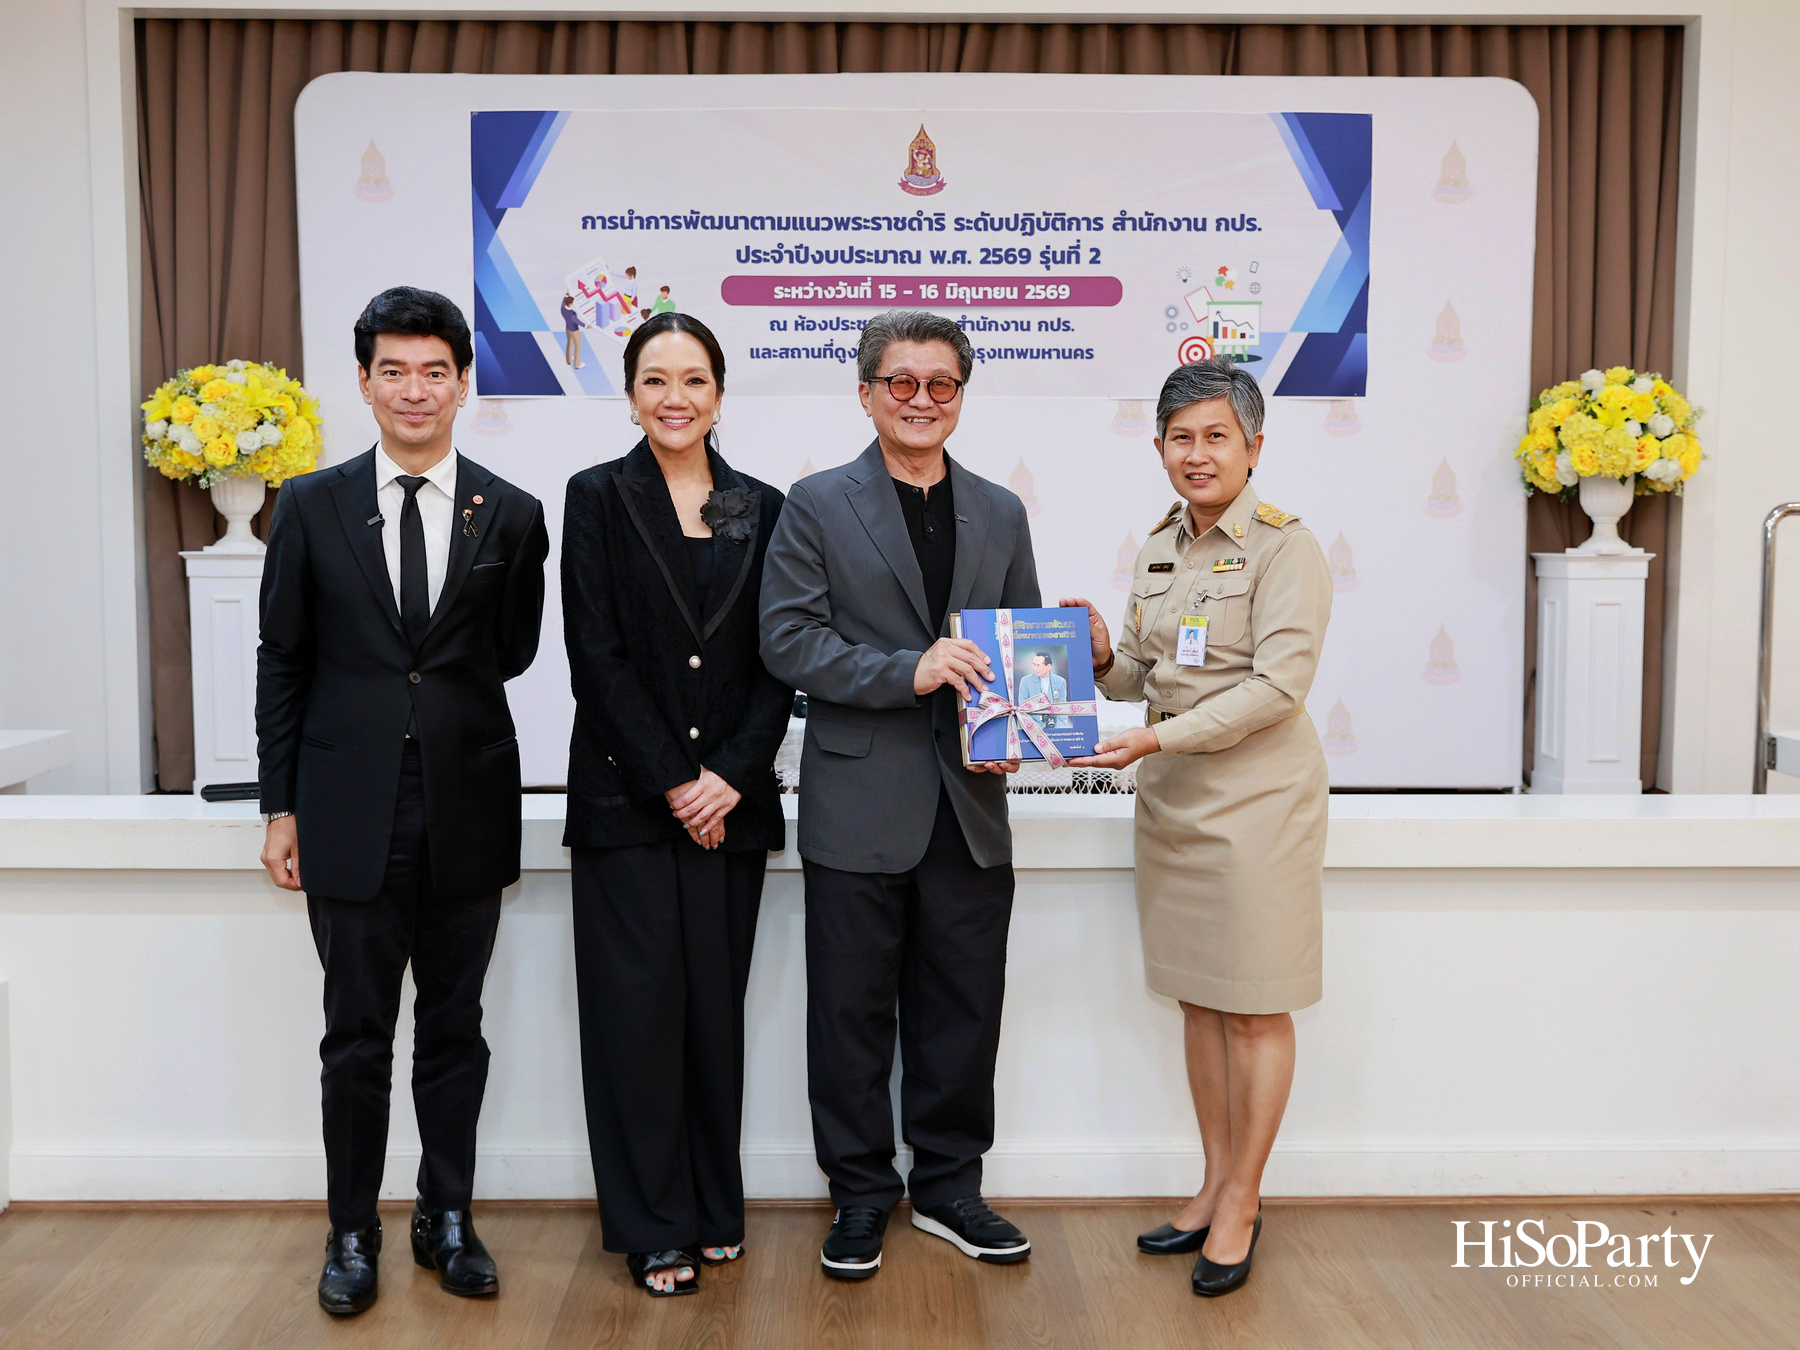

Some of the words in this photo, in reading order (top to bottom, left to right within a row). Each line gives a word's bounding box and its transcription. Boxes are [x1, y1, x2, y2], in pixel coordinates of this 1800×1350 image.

[581, 209, 946, 232] การนำการพัฒนาตามแนวพระราชดำริ
[954, 211, 1104, 237] ระดับปฏิบัติการ
[1112, 210, 1207, 232] สำนักงาน
[1215, 214, 1262, 232] กปร.
[736, 243, 921, 265] ประจำปีงบประมาณ
[930, 248, 972, 265] พ.ศ.
[979, 247, 1032, 265] 2569
[1039, 239, 1081, 271] รุ่นที่
[1089, 247, 1101, 265] 2
[773, 277, 872, 300] ระหว่างวันที่
[878, 283, 897, 299] 15
[918, 284, 939, 299] 16
[945, 283, 1018, 305] มิถุนายน
[1024, 284, 1071, 300] 2569
[769, 319, 787, 331] ณ
[794, 316, 869, 332] ห้องประช
[1037, 317, 1075, 332] กปร.
[750, 340, 858, 363] และสถานที่ดูง
